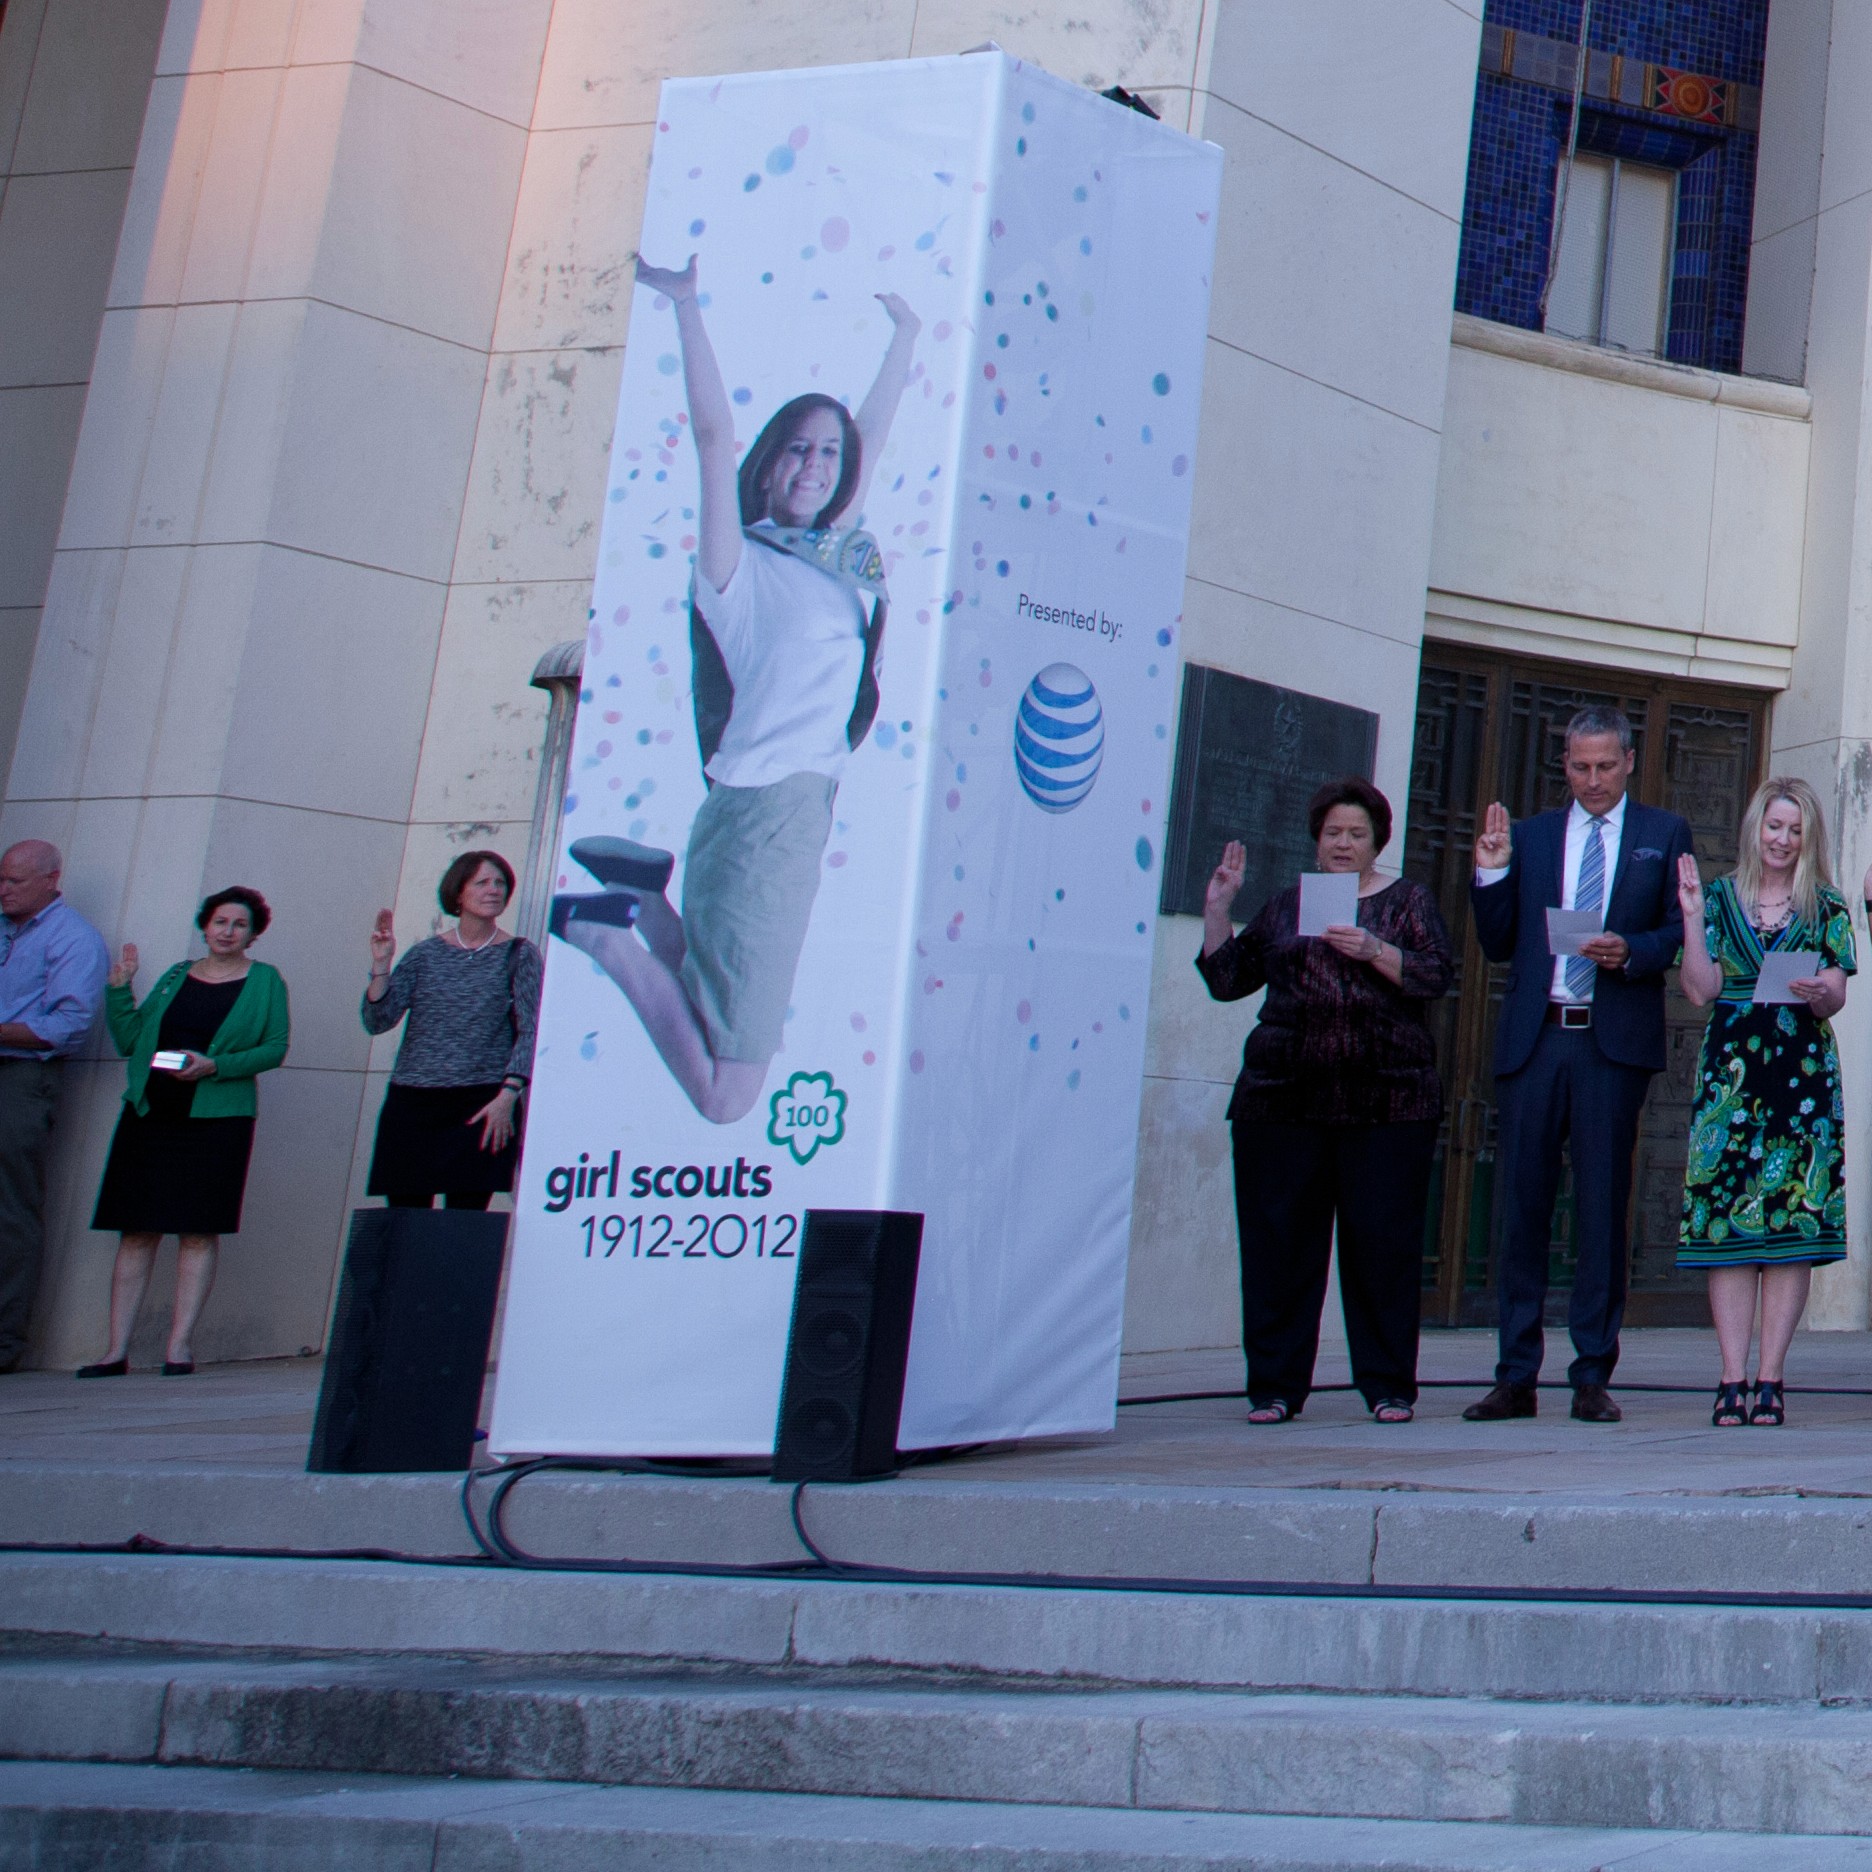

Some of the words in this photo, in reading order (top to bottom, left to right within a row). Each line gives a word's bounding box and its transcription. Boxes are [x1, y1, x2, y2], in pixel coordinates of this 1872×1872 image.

[1018, 593, 1097, 632] Presented
[1100, 610, 1123, 643] by:
[785, 1104, 829, 1128] 100
[544, 1150, 620, 1212] girl
[630, 1156, 773, 1198] scouts
[581, 1214, 798, 1258] 1912-2012
